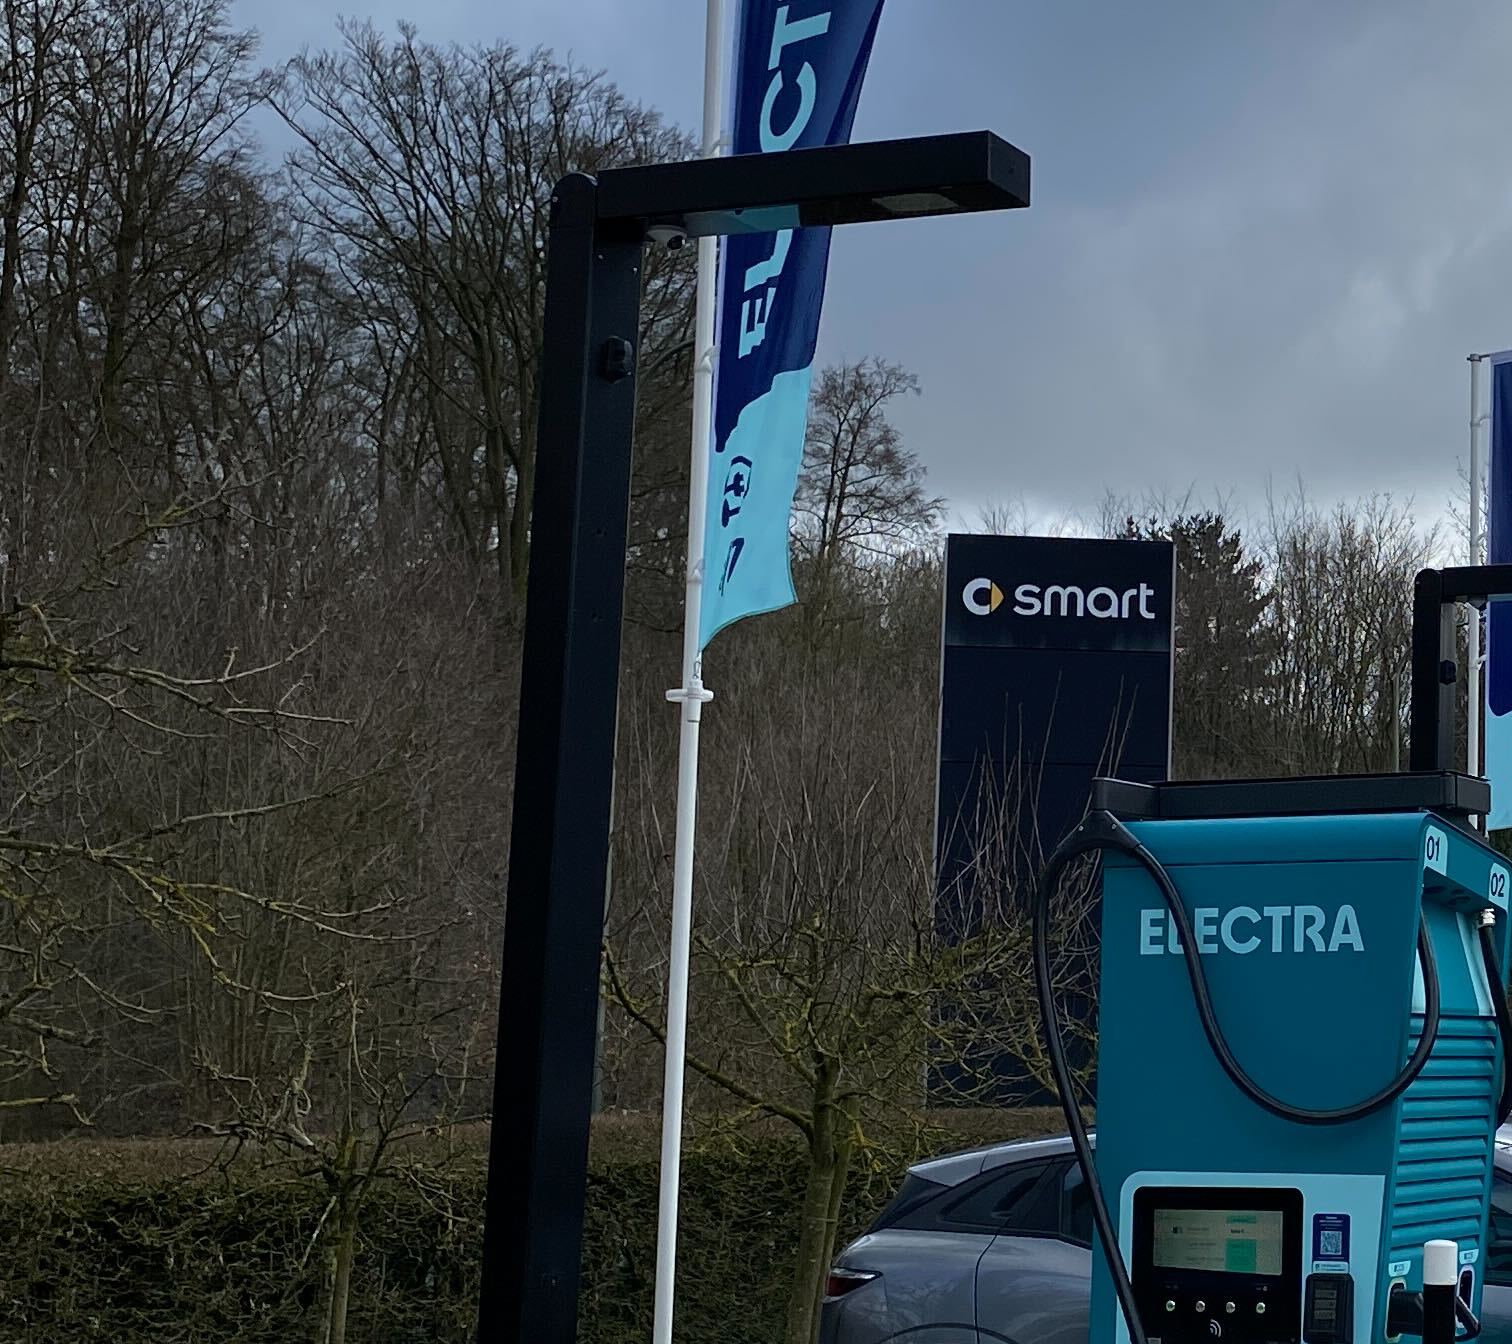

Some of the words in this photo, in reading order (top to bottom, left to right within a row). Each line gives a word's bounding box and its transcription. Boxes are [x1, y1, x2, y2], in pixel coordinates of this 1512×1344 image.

[1013, 583, 1156, 619] smart
[1426, 835, 1441, 862] 01
[1490, 872, 1506, 898] 02
[1140, 904, 1365, 955] ELECTRA
